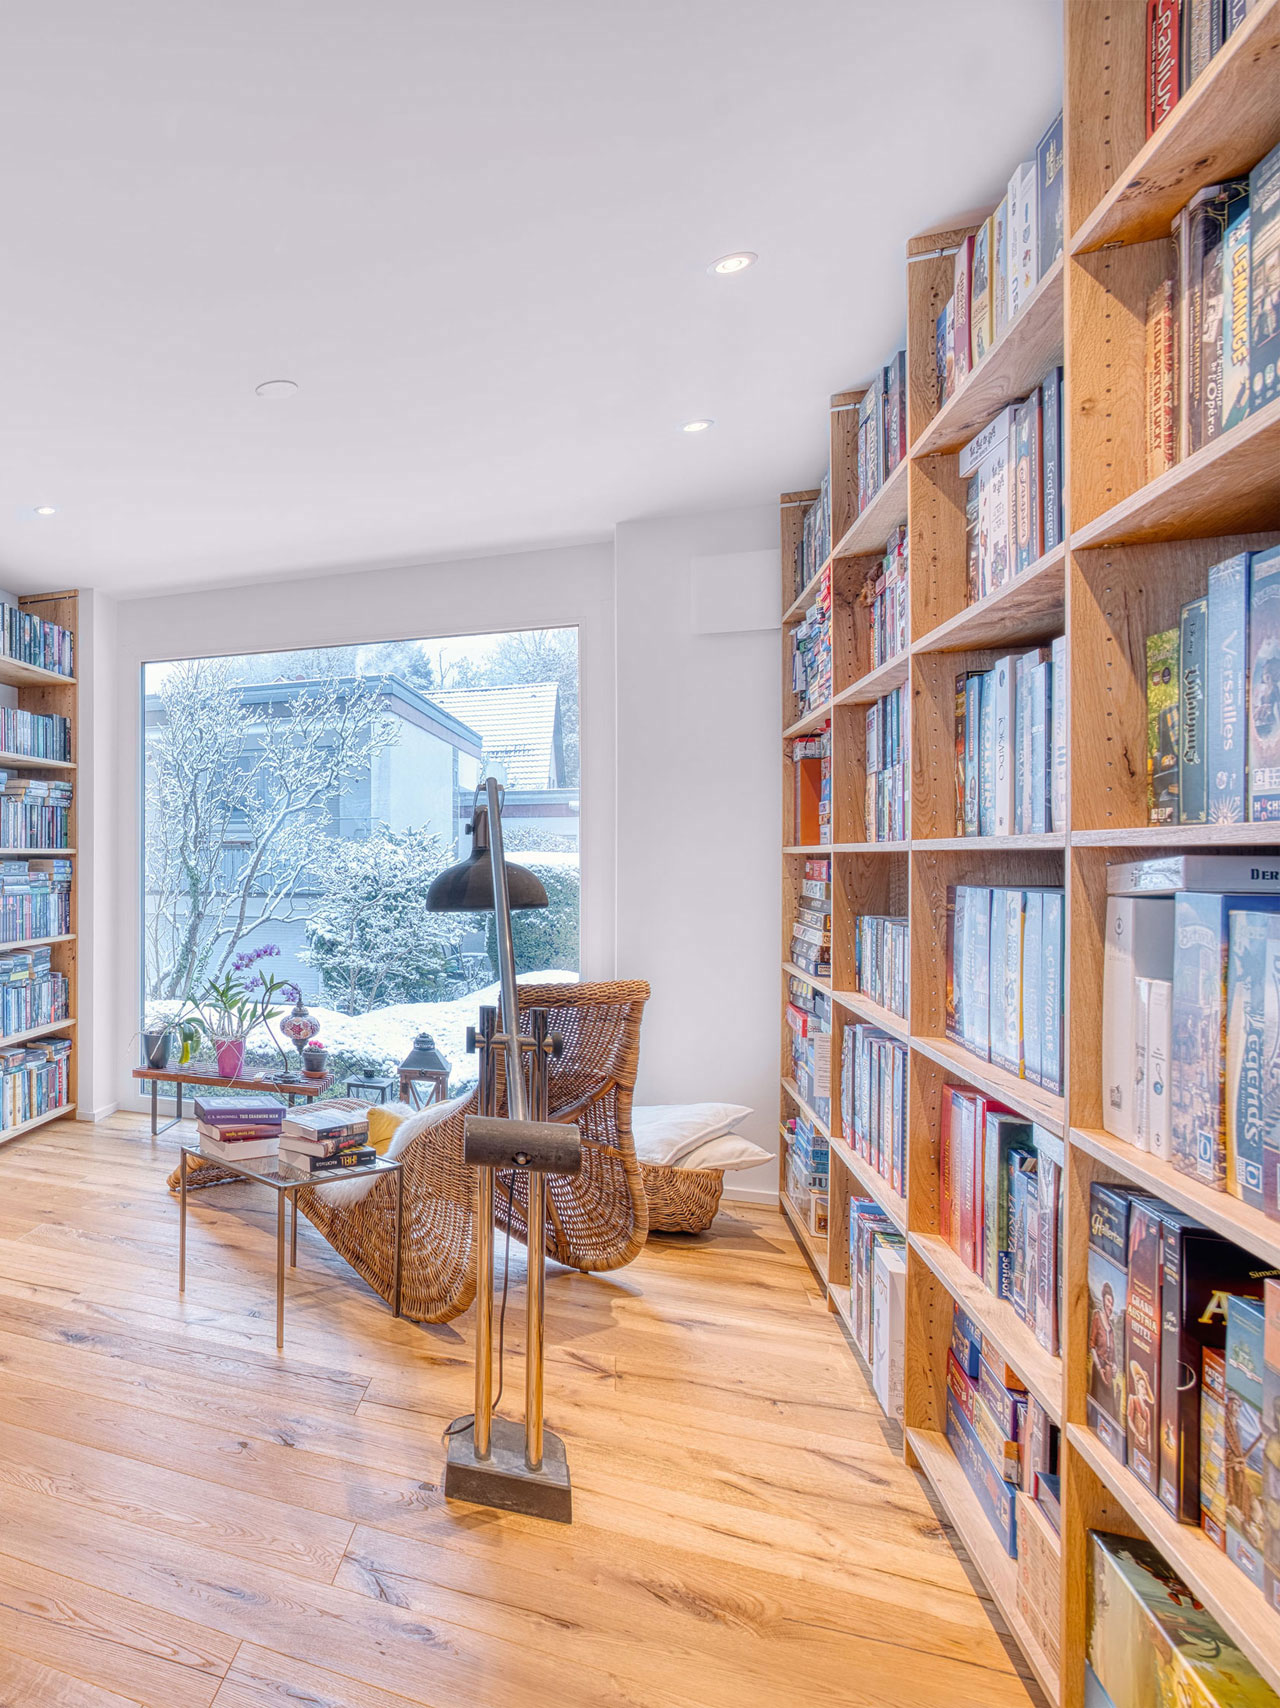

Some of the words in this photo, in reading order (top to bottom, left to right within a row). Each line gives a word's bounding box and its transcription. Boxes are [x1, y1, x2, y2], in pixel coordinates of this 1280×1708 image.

[1046, 460, 1056, 547] Kraftwagen
[1222, 629, 1238, 751] Versailles
[1253, 798, 1280, 812] HUCH
[1250, 868, 1280, 881] DER
[1131, 1293, 1154, 1317] GRAND
[1127, 1303, 1158, 1336] AUSTRIA
[1131, 1319, 1153, 1343] HOTEL
